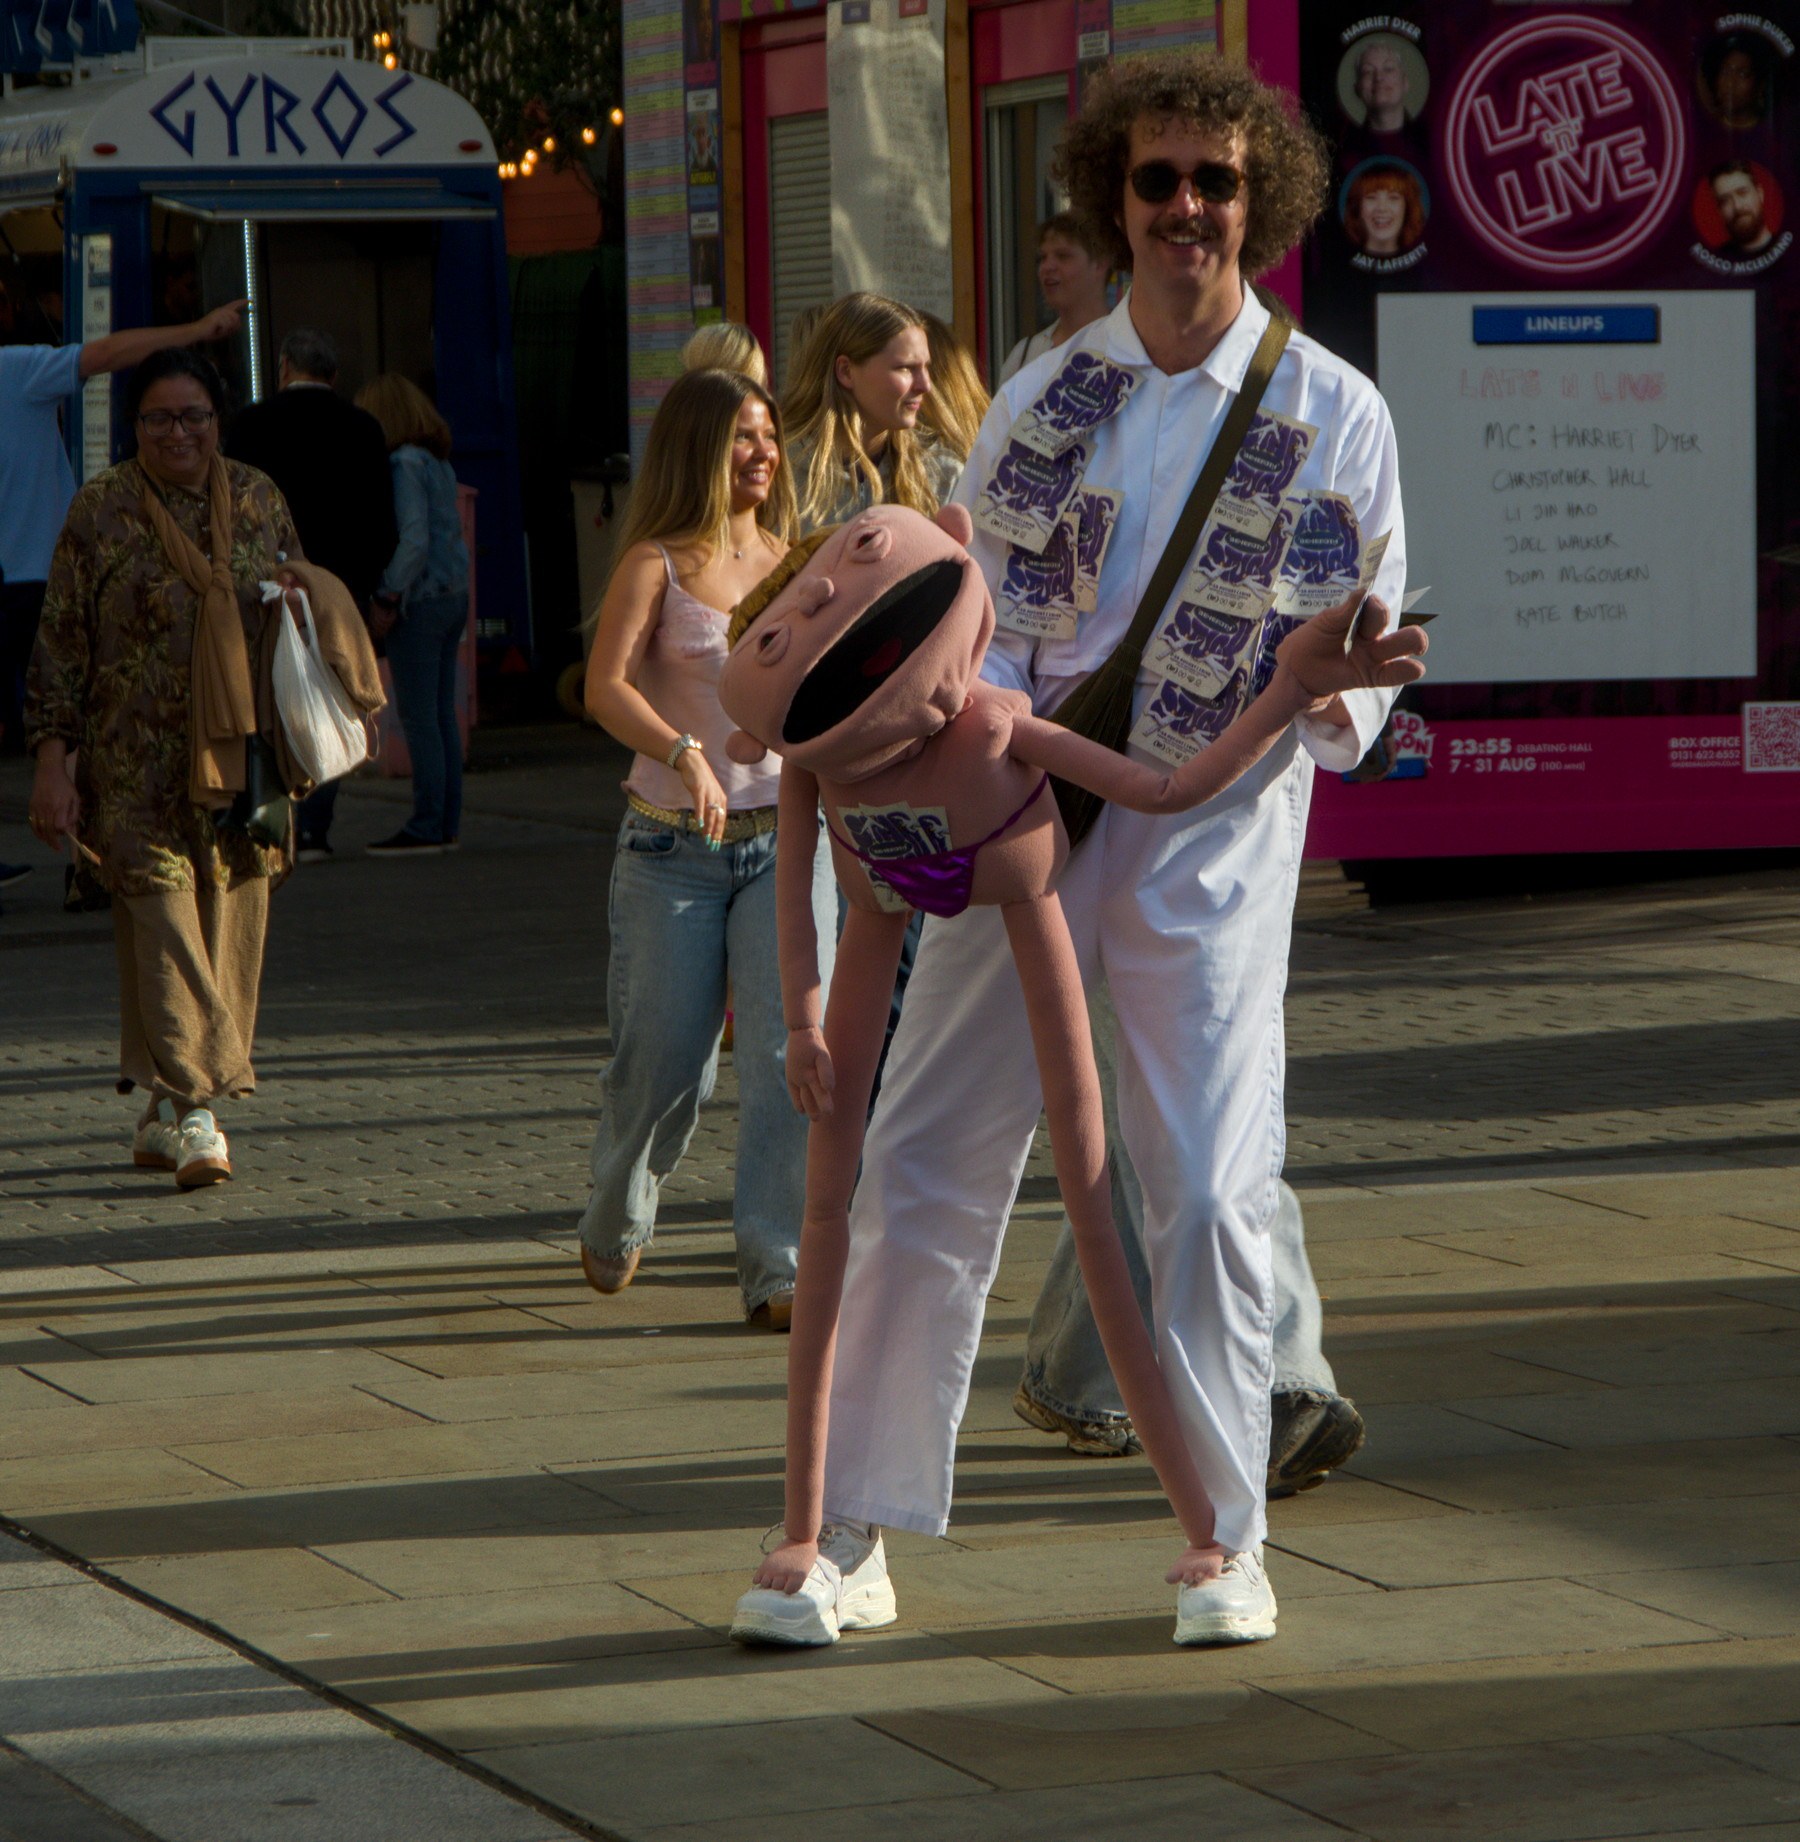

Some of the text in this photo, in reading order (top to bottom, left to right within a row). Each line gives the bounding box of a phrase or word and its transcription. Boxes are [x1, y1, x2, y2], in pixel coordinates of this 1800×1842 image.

[1341, 14, 1421, 43] HARRIET DYER
[1718, 12, 1762, 32] SOPHIE
[150, 70, 416, 158] GYROS
[1472, 49, 1634, 155] LATE
[1496, 125, 1659, 236] LIVE
[1352, 241, 1429, 274] JAY LAFFERTY
[1690, 241, 1732, 273] ROSCO
[1525, 315, 1605, 333] LINEUPS
[1459, 368, 1542, 398] LATE
[1484, 422, 1702, 454] MC: HARRIET DYER
[1492, 466, 1652, 492] CHRISTOPHER HALL
[1556, 532, 1620, 552] WALKER
[1515, 603, 1628, 627] KATE BUTCH
[1450, 738, 1593, 755] 23:55 DEBATING HALL
[1670, 736, 1741, 748] BOX OFFICE
[1670, 750, 1693, 760] 0131
[1695, 750, 1715, 760] 622
[1450, 758, 1461, 774] 7
[1474, 758, 1493, 773] 31
[1498, 757, 1537, 773] AUG
